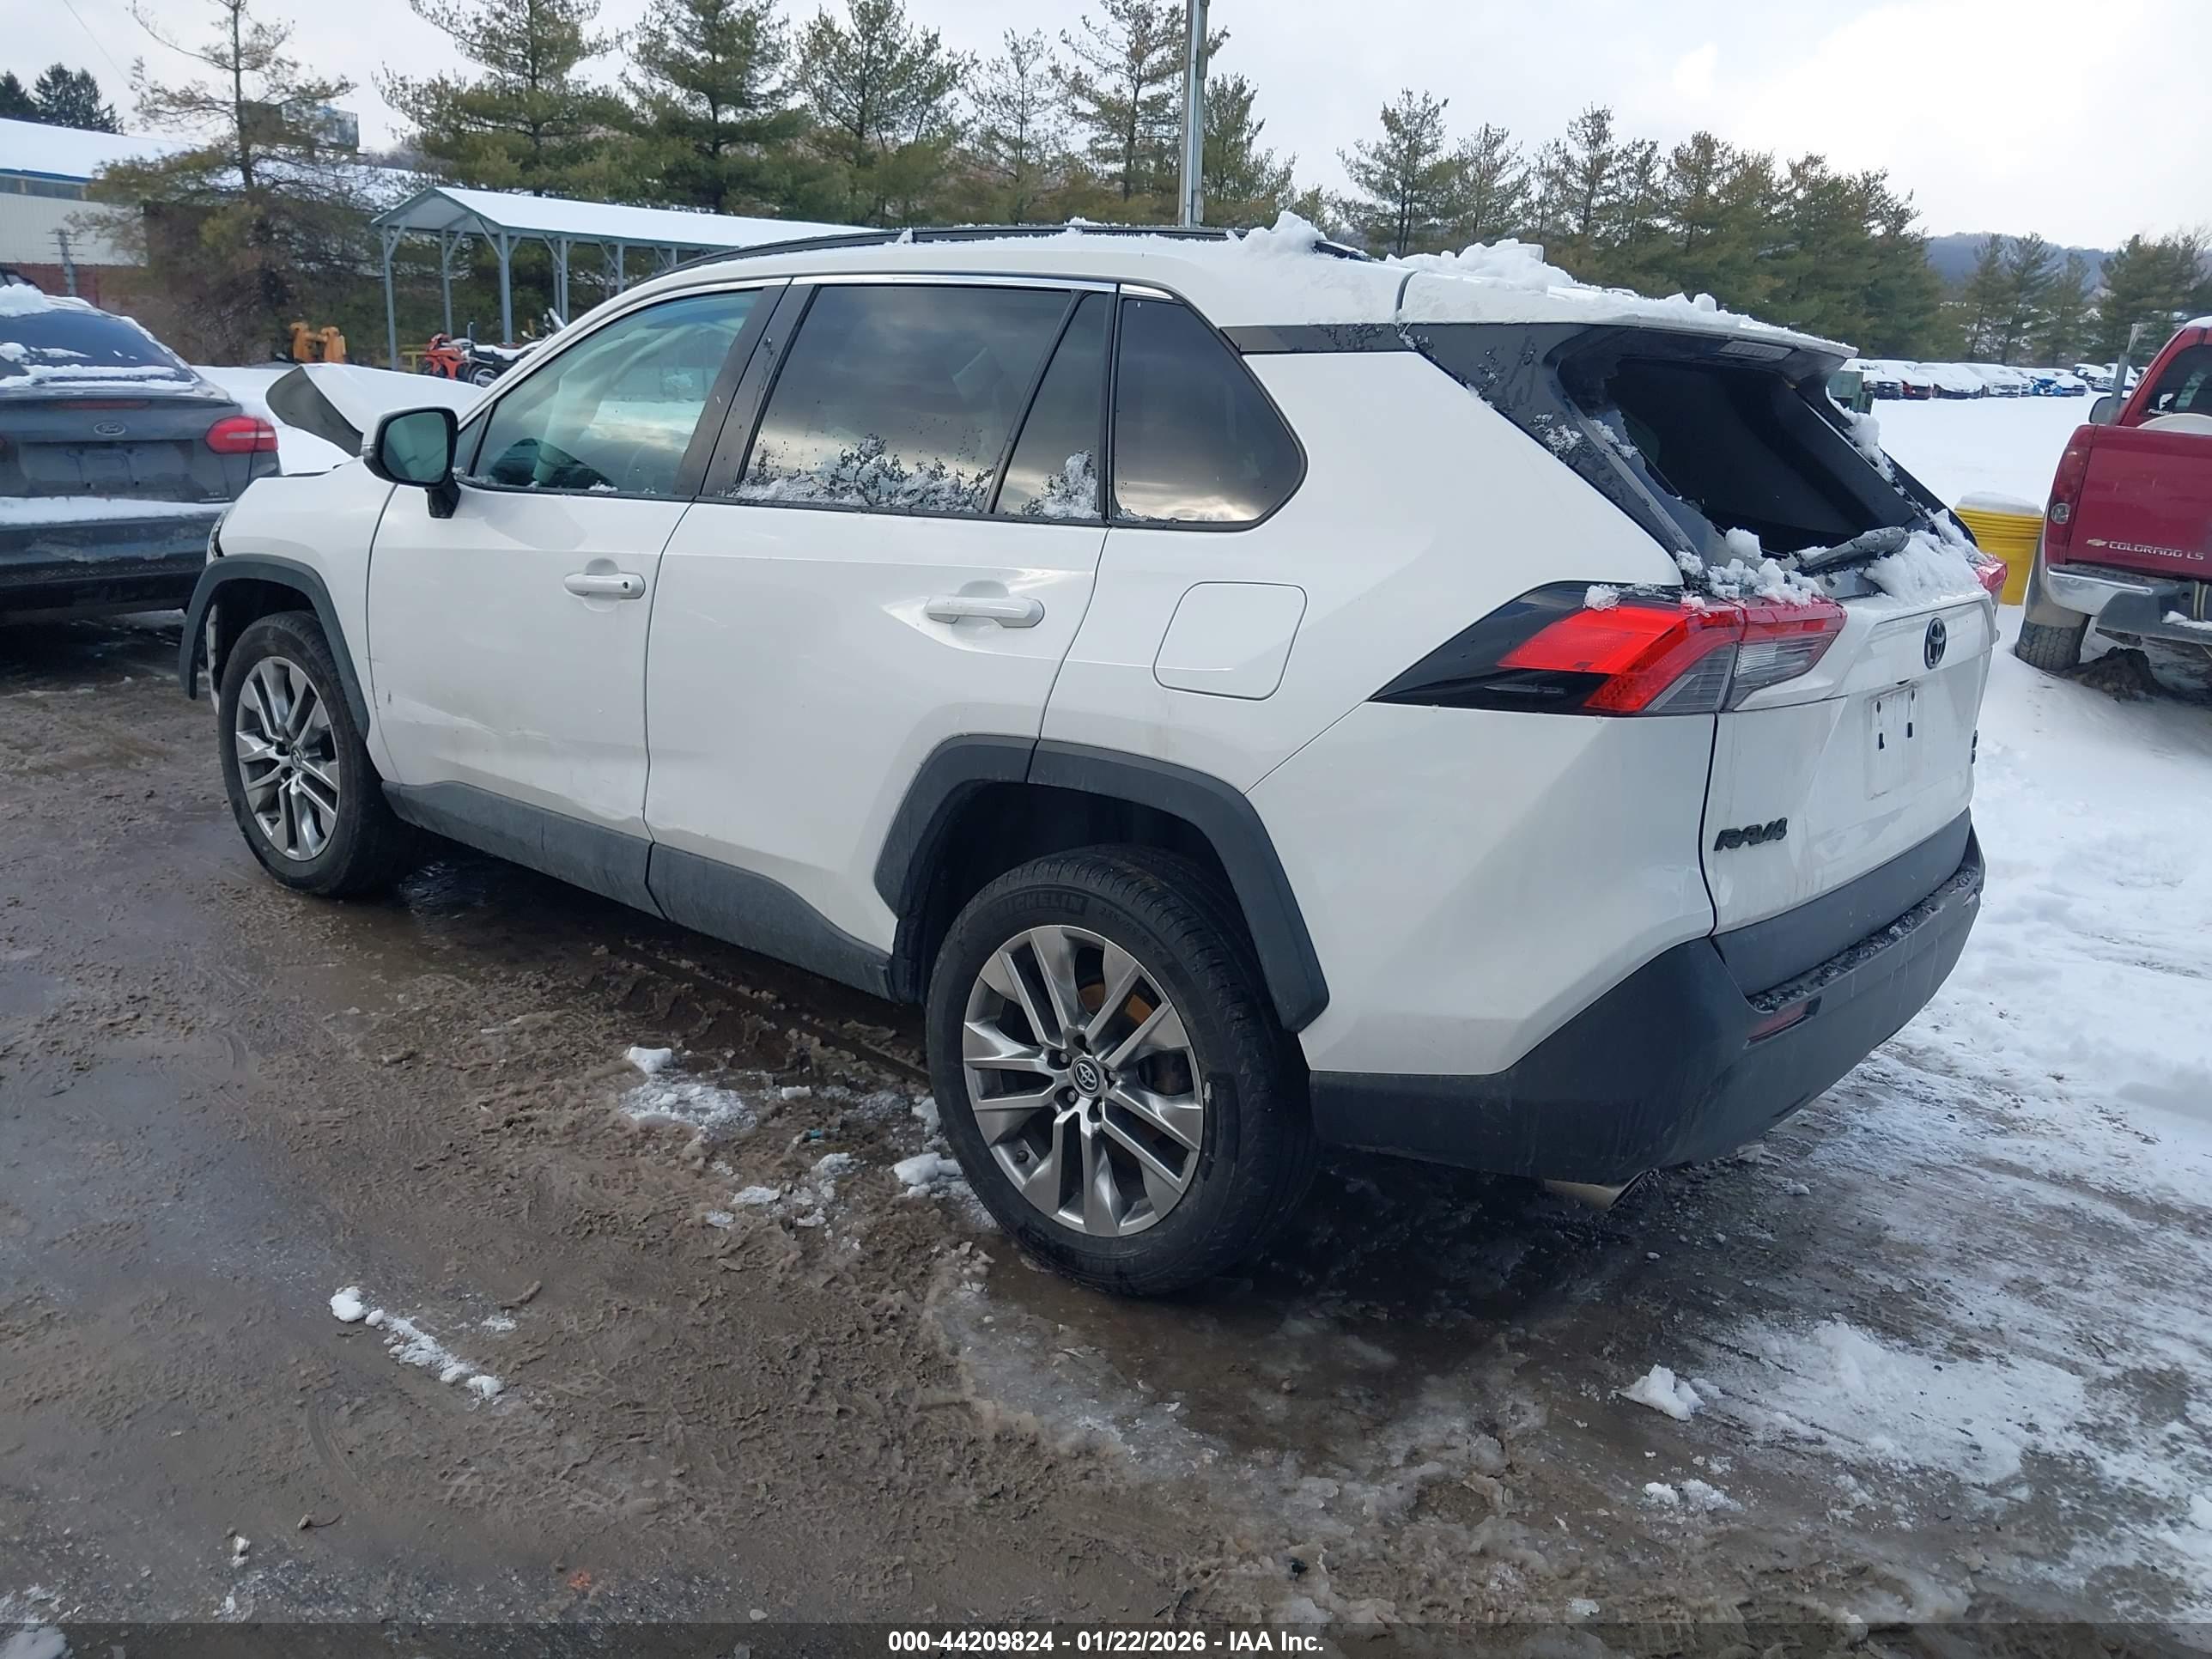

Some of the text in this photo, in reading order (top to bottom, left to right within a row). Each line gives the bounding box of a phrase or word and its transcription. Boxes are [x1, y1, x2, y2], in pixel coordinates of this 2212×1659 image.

[2108, 541, 2204, 561] COLORADO LS
[1714, 817, 1788, 851] RAV4
